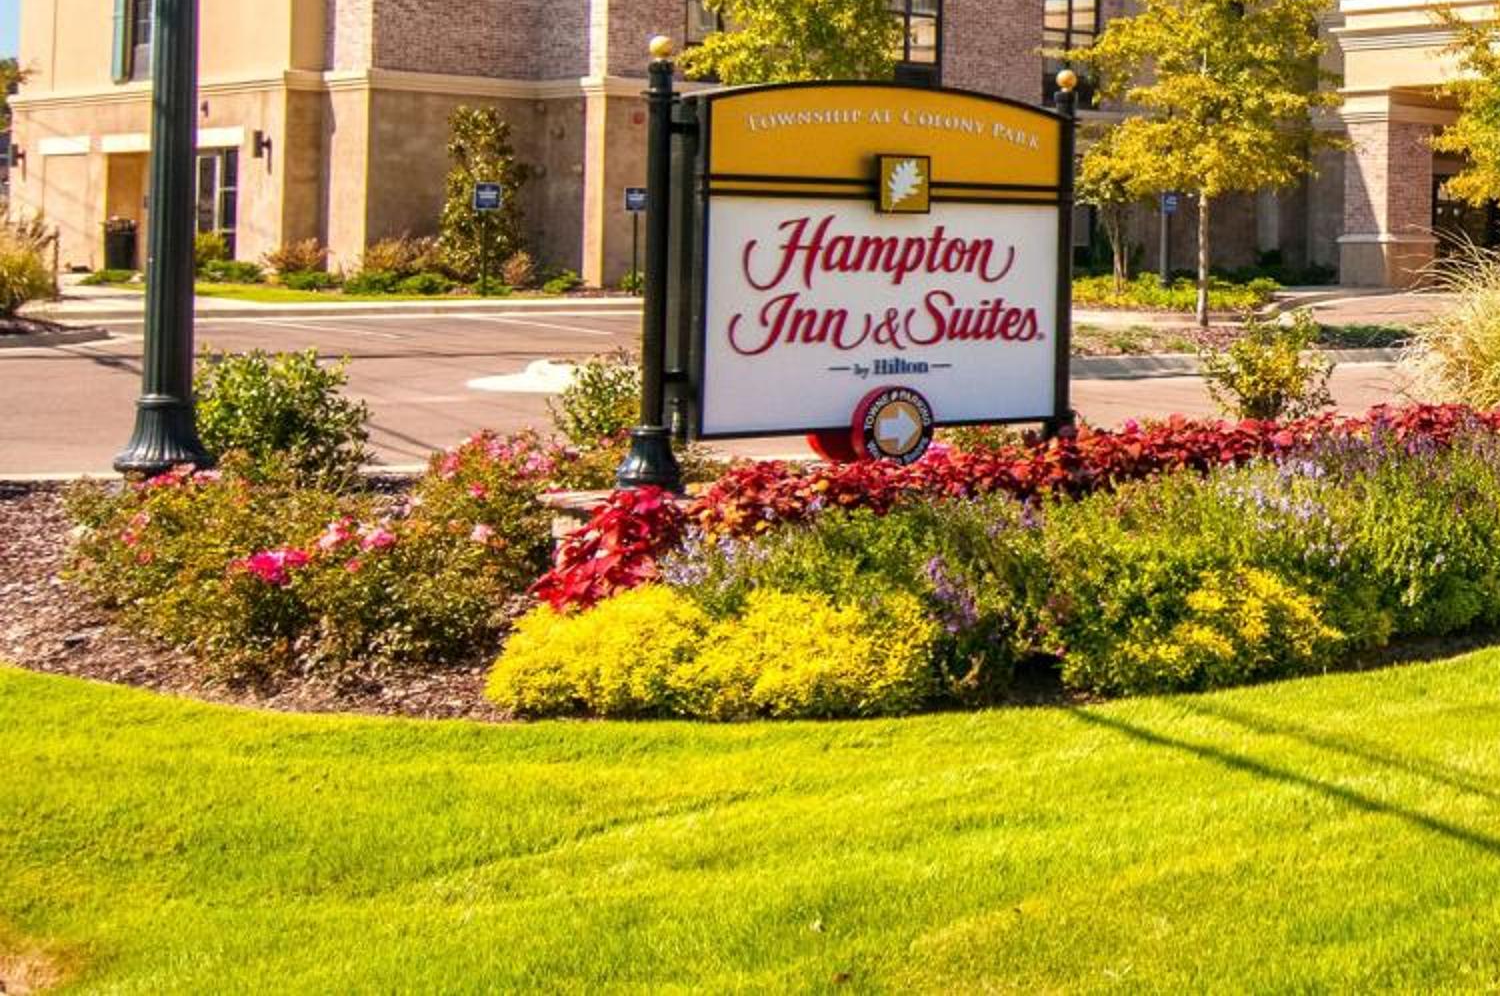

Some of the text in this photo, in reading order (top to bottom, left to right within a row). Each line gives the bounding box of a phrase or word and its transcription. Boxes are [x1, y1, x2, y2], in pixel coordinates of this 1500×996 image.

[746, 109, 862, 132] TOWNSHIP
[742, 215, 1016, 291] Hampton
[728, 292, 872, 357] Inn
[873, 307, 906, 351] &
[853, 356, 929, 381] by Hilton
